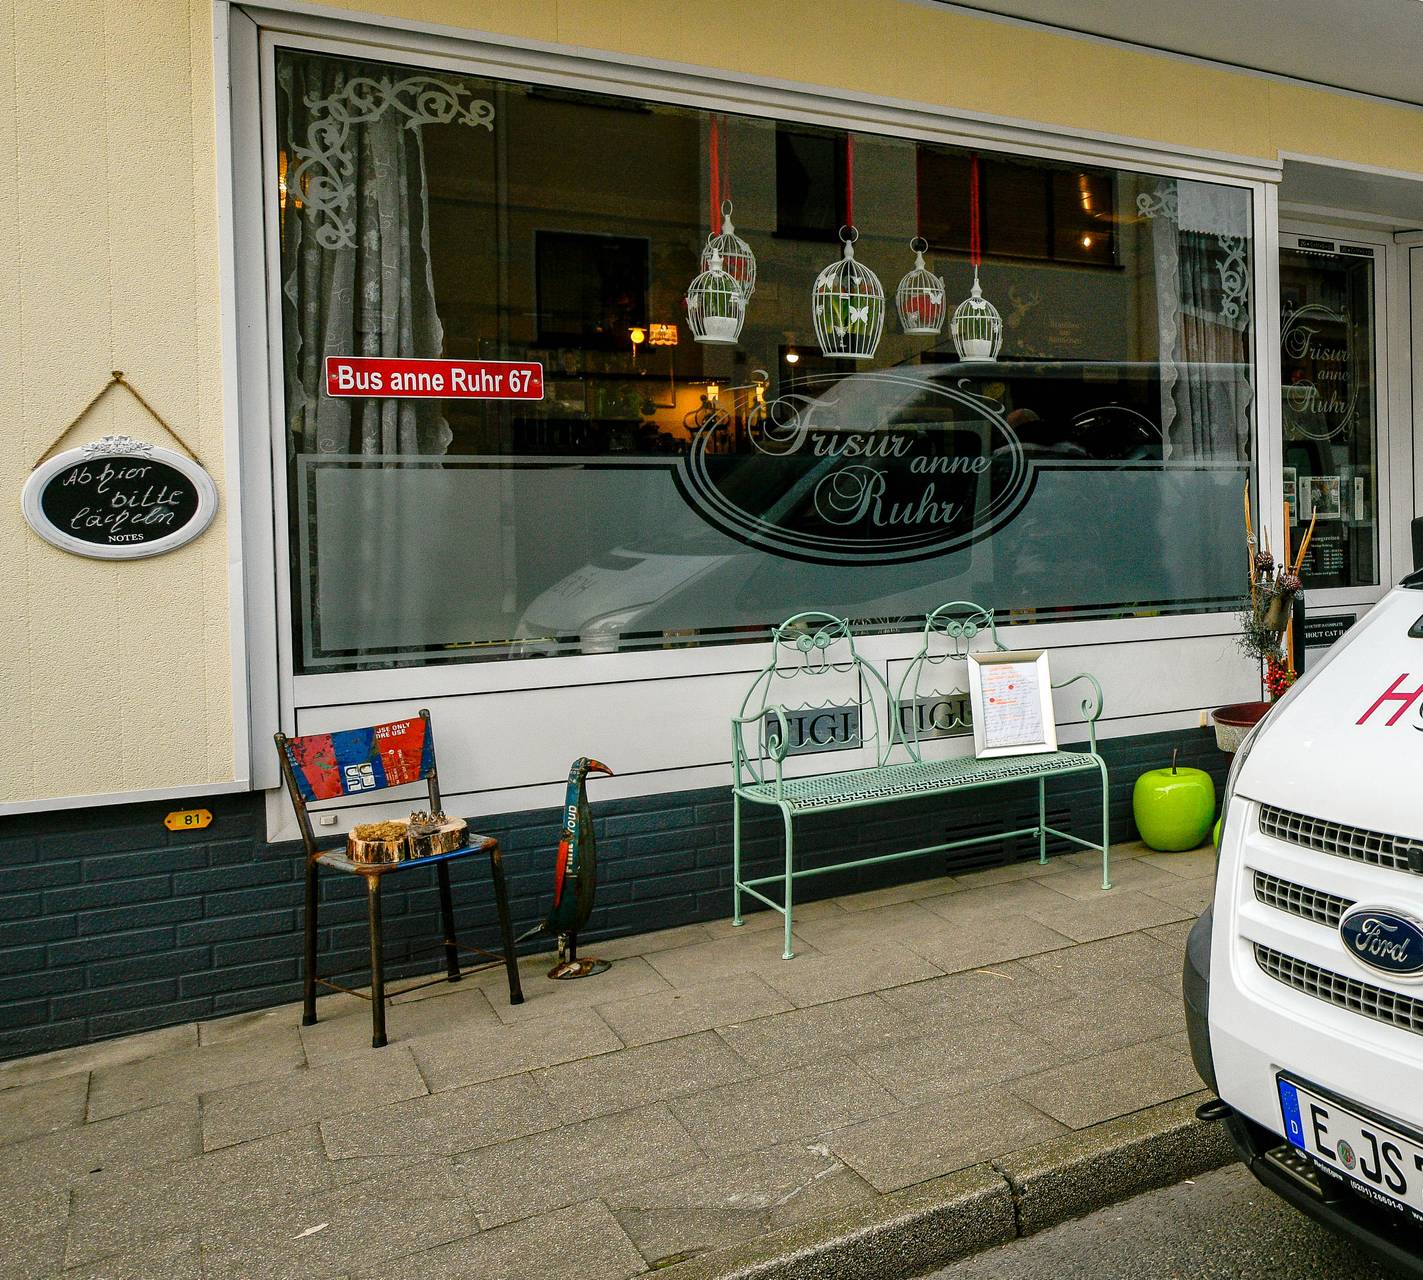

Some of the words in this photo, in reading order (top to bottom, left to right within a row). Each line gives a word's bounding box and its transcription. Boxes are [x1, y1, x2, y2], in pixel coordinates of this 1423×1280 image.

[337, 365, 383, 390] Bus
[390, 371, 445, 391] anne
[451, 368, 504, 392] Ruhr
[509, 370, 532, 393] 67
[1287, 379, 1349, 414] Ruhr
[748, 394, 914, 456] Frisur
[63, 467, 92, 486] Ab
[910, 454, 992, 475] anne
[814, 465, 963, 526] Ruhr
[108, 533, 144, 543] NOTES
[392, 722, 410, 731] ONLY
[766, 712, 854, 748] TIGI
[899, 699, 969, 736] TIGI
[184, 814, 200, 825] 81
[1355, 918, 1410, 962] Ford
[1290, 1119, 1299, 1134] D
[1310, 1103, 1337, 1161] E
[1360, 1129, 1407, 1195] JS
